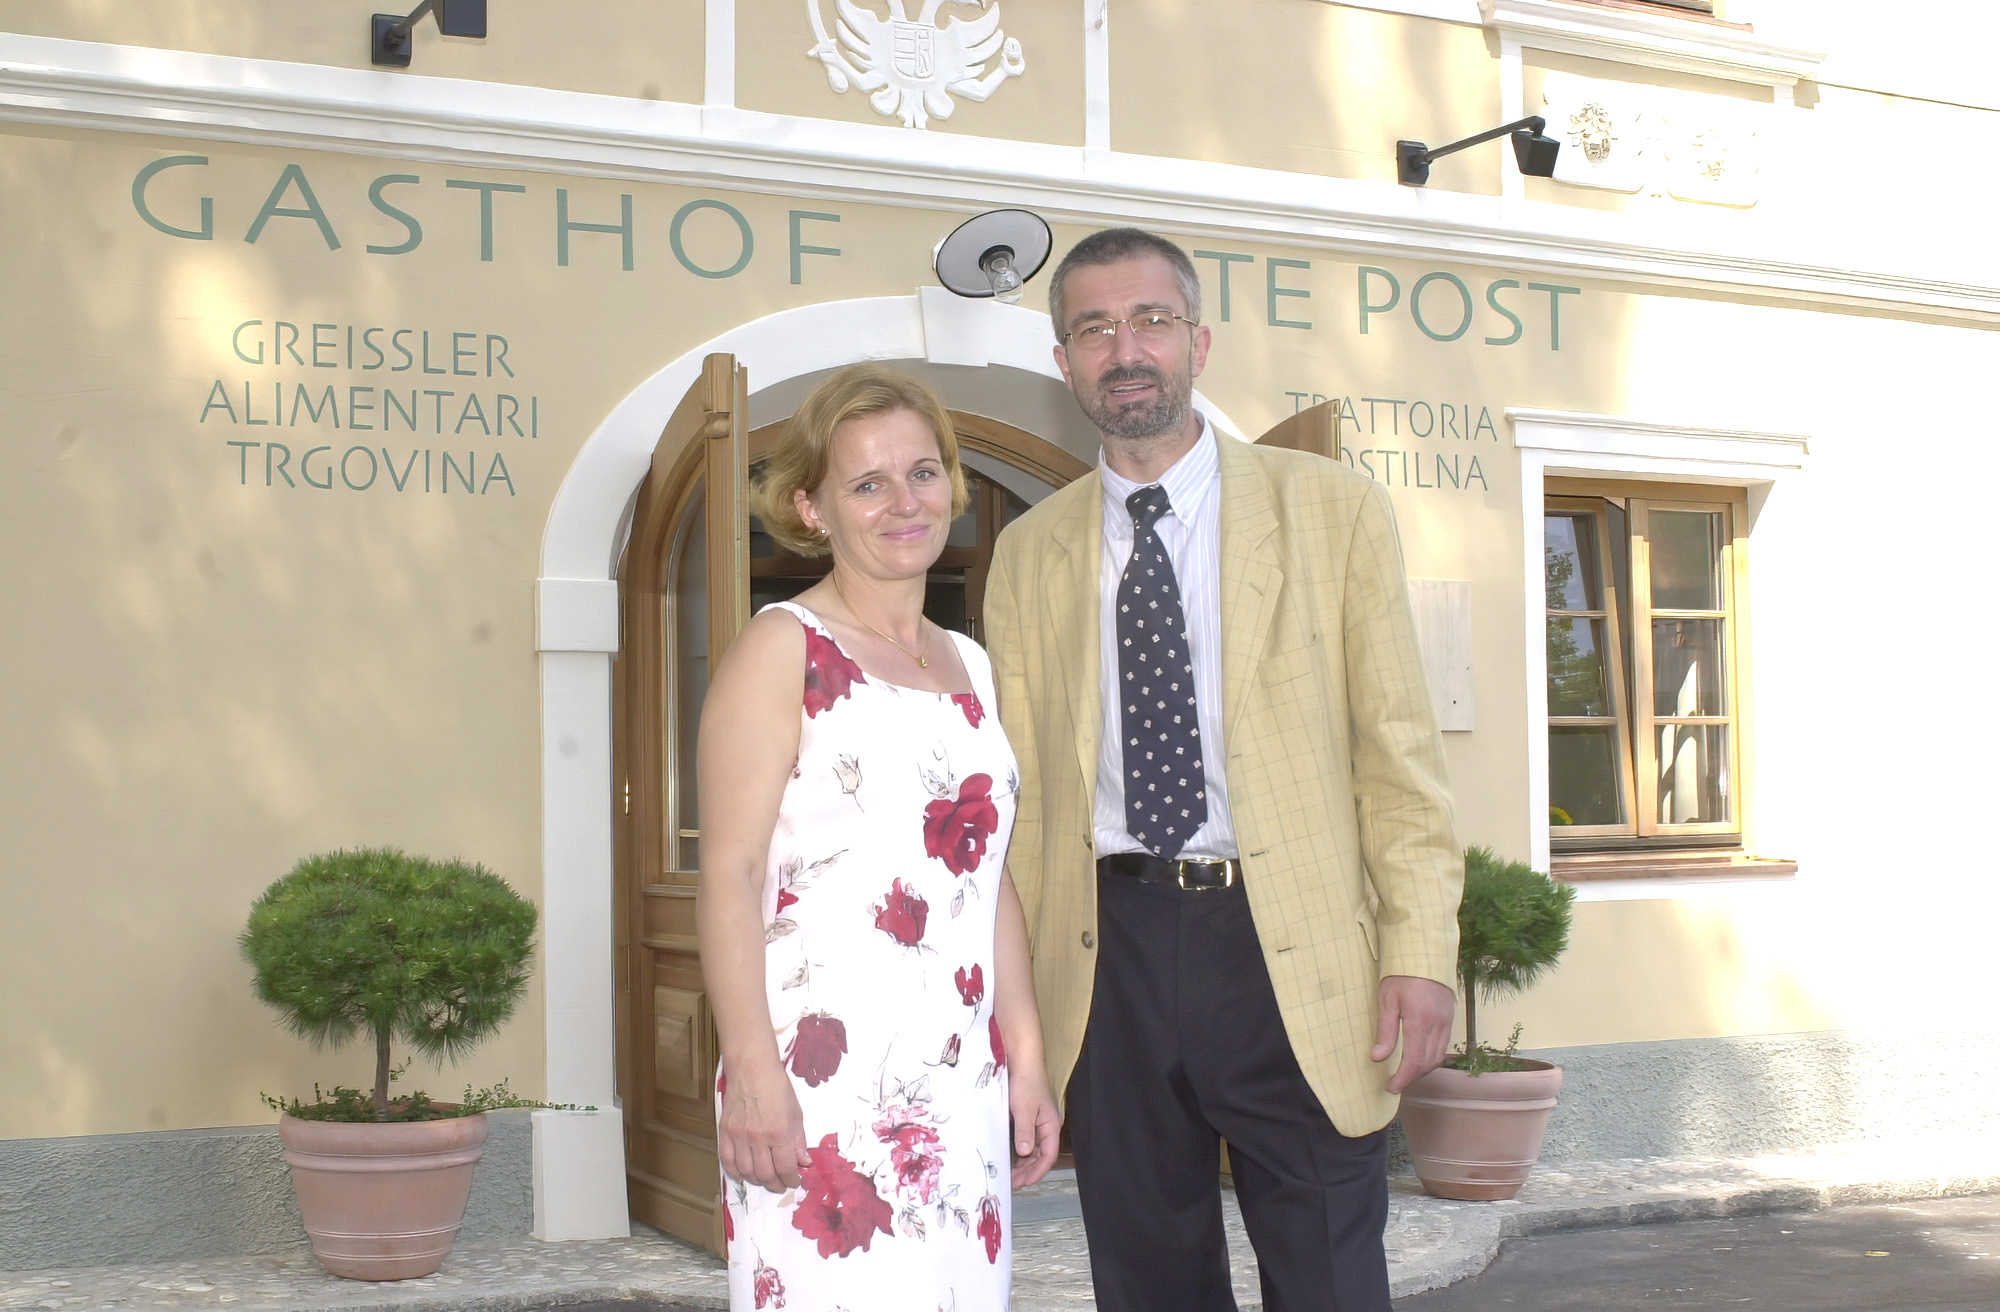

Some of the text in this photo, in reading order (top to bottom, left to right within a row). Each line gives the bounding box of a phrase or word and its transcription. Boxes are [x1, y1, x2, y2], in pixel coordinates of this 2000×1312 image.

[130, 154, 1582, 351] GASTHOF TE POST
[231, 319, 516, 379] GREISSLER
[199, 379, 539, 439] ALIMENTARI
[226, 440, 517, 496] TRGOVINA
[1342, 446, 1488, 491] STILNA
